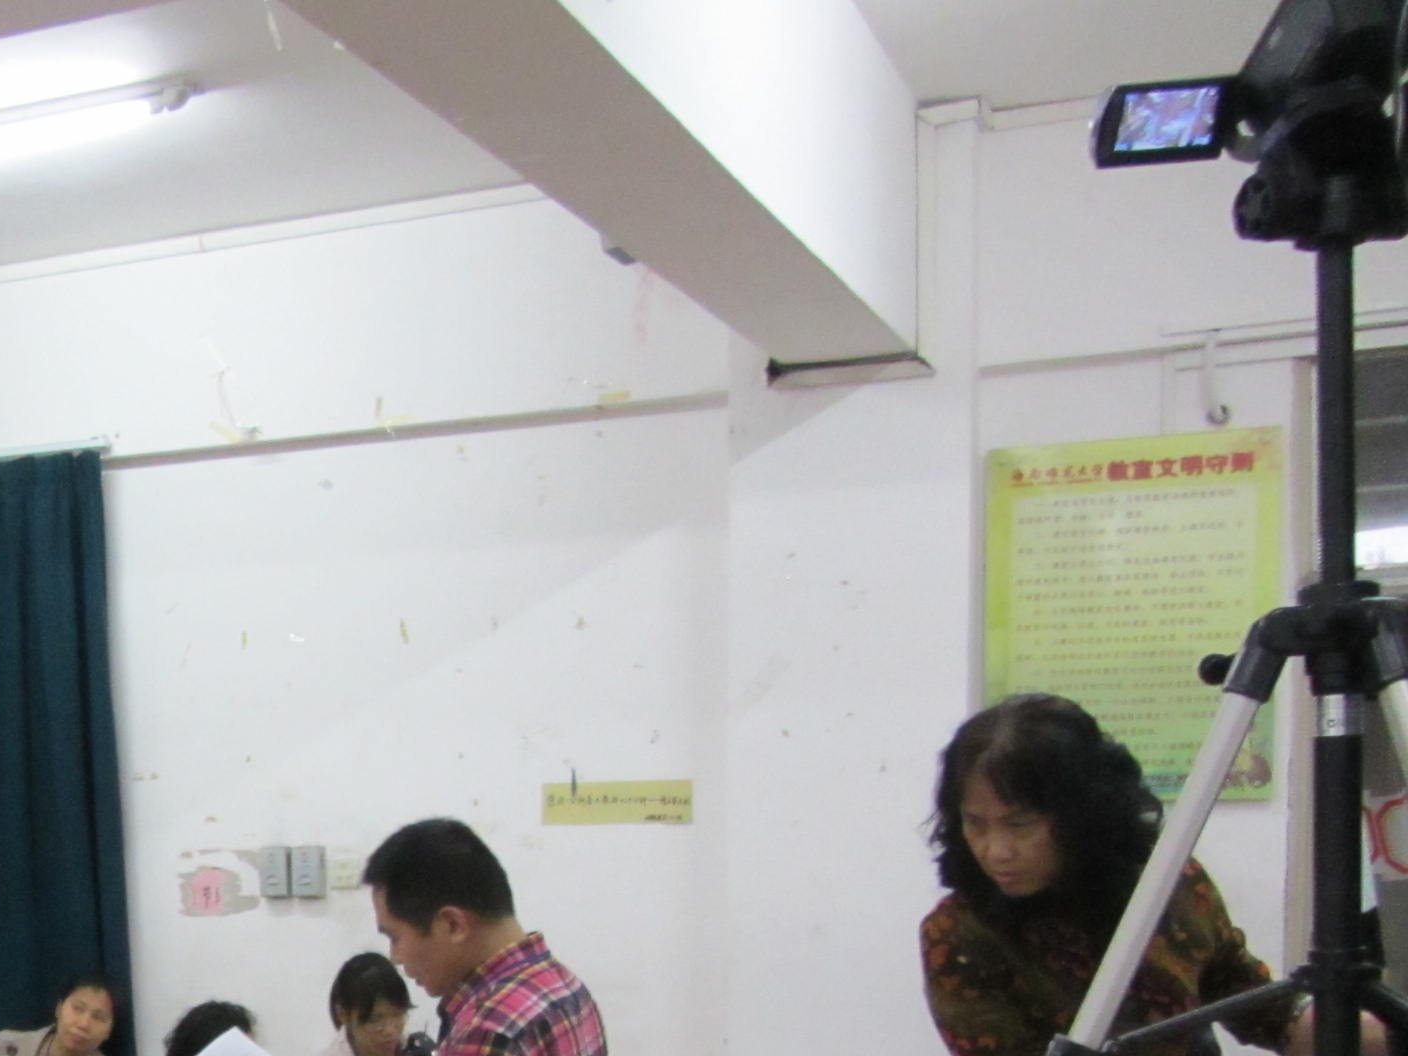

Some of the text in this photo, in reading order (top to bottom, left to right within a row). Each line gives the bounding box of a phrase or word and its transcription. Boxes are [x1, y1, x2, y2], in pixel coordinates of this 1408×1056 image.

[1107, 451, 1255, 482] 教室文明守则
